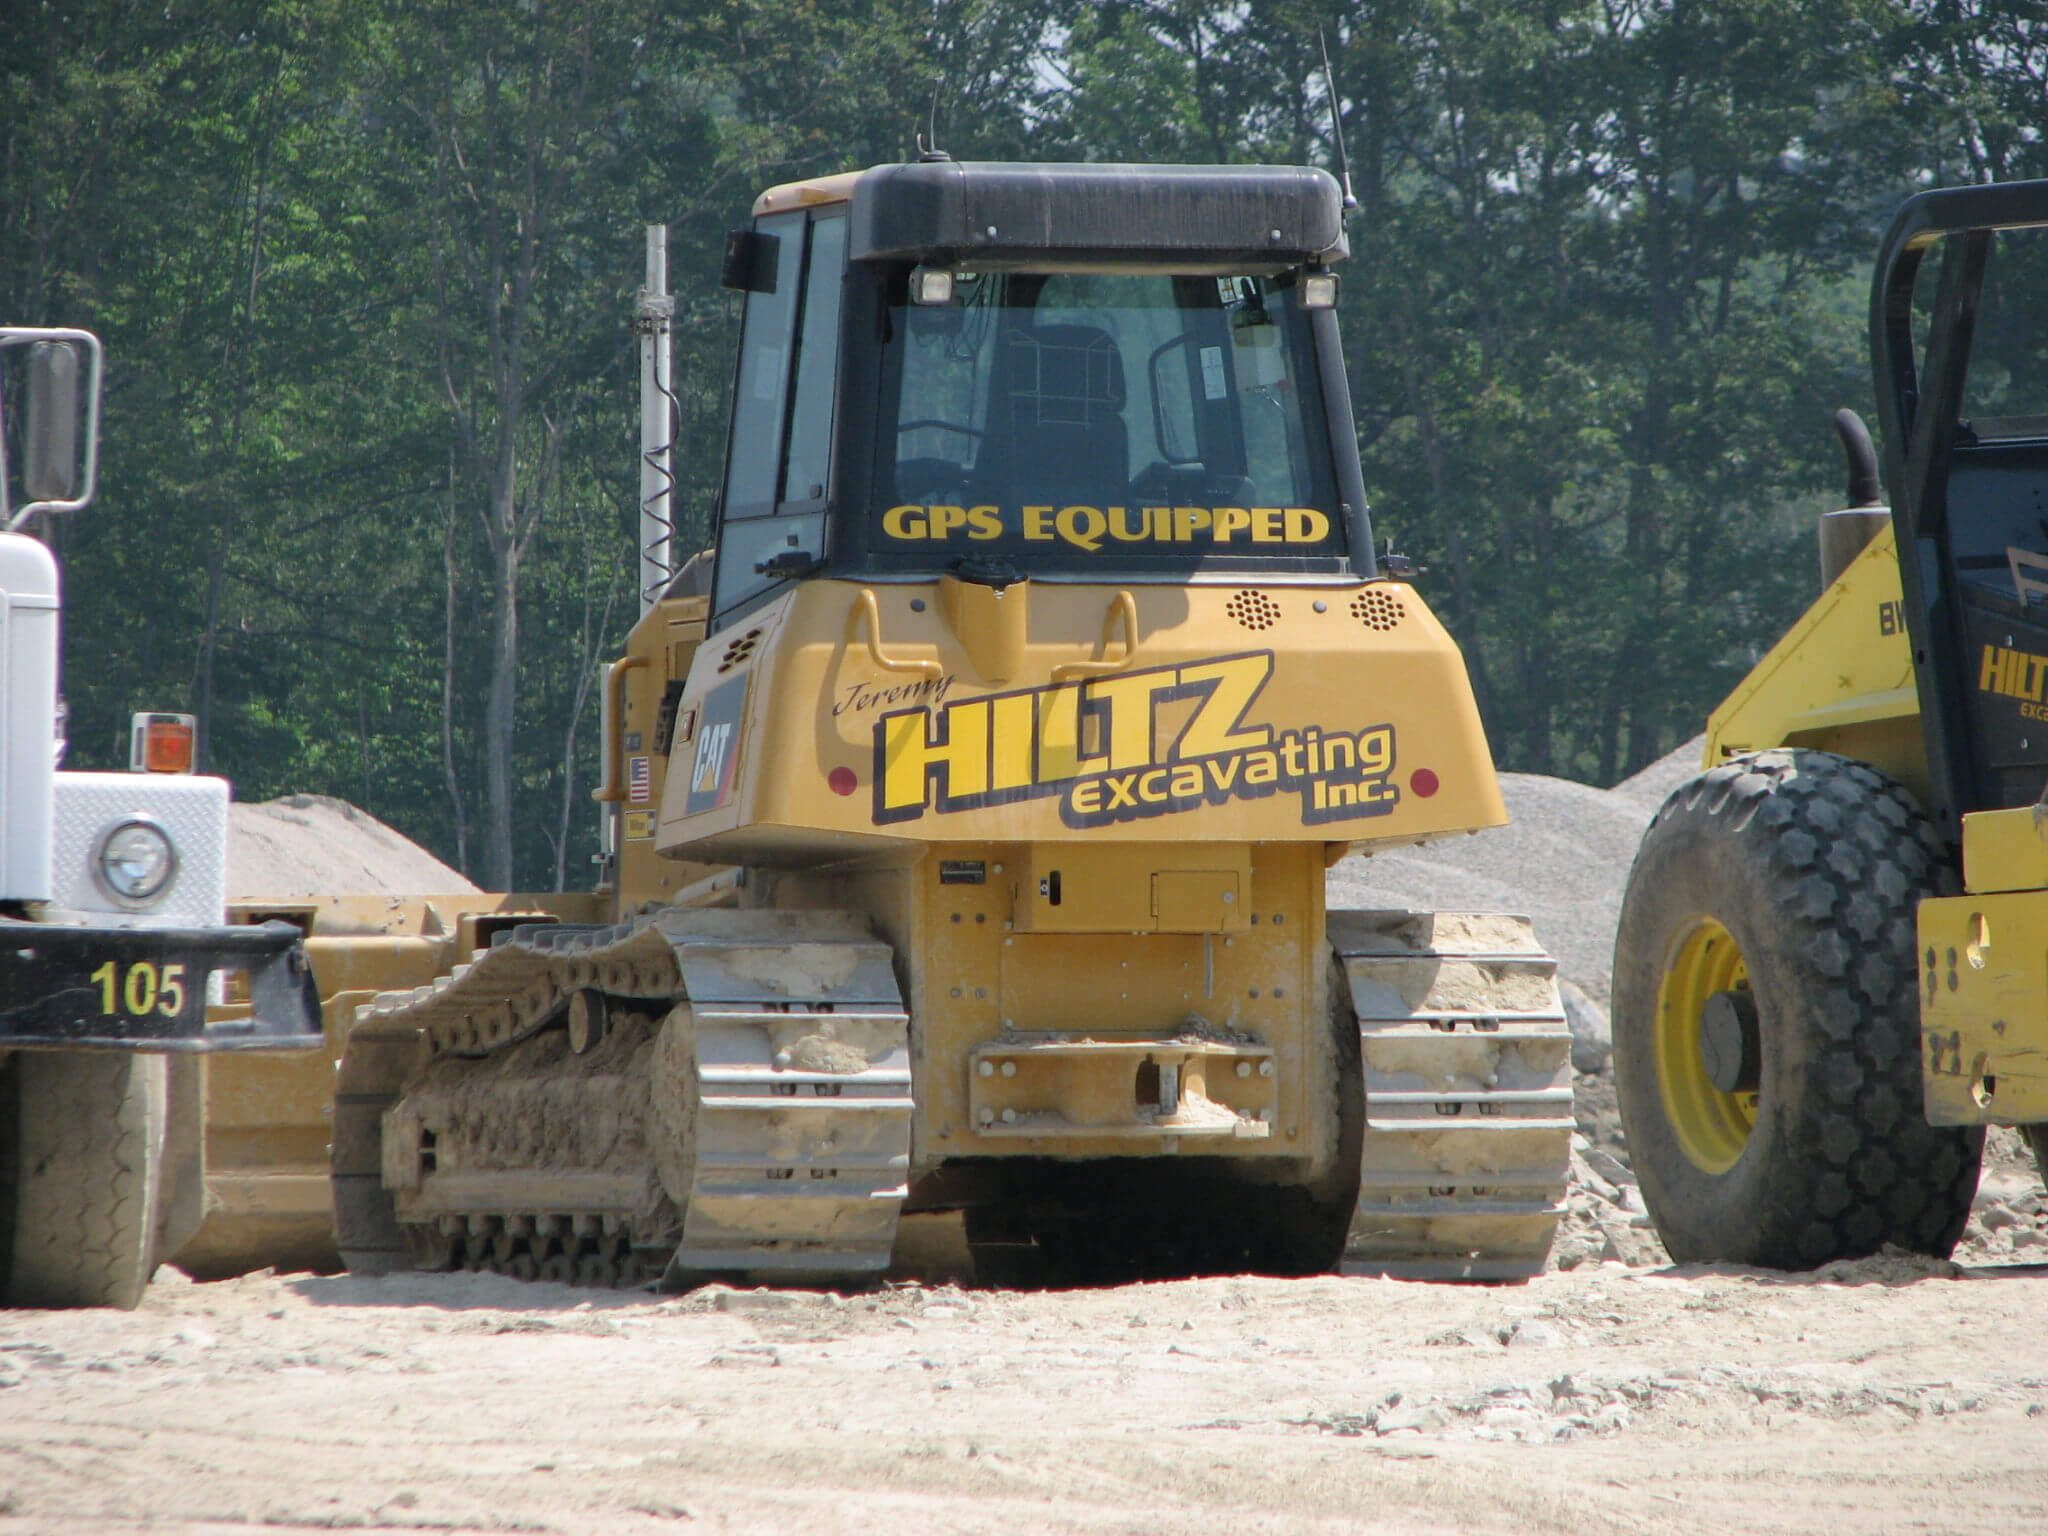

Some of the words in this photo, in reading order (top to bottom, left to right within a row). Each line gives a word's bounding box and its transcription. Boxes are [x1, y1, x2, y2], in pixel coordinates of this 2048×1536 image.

[882, 505, 1003, 541] GPS
[1023, 505, 1330, 551] EQUIPPED
[832, 674, 958, 716] Jeremy
[1979, 644, 2048, 704] HILT
[692, 723, 731, 792] CAT
[875, 650, 1274, 822] HILTZ
[1068, 725, 1393, 820] excavating
[1311, 777, 1396, 816] Inc.
[91, 961, 184, 1017] 105
